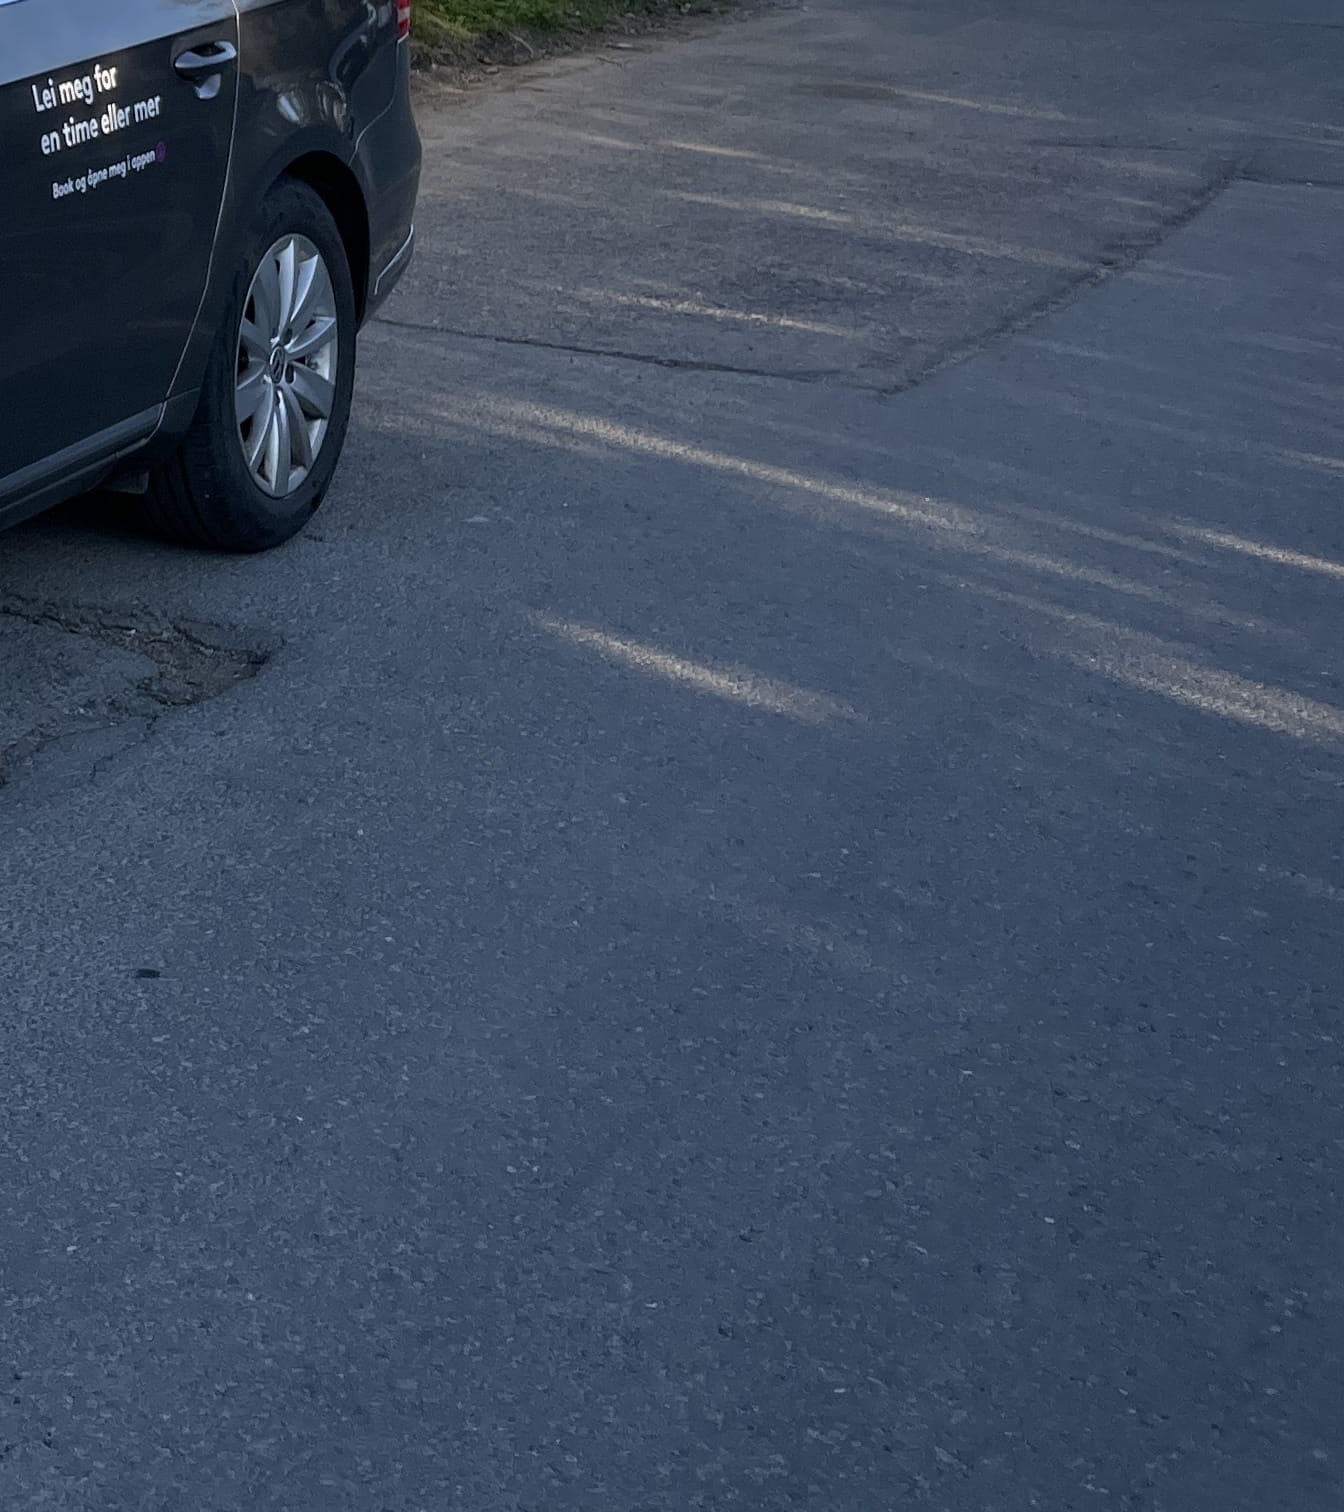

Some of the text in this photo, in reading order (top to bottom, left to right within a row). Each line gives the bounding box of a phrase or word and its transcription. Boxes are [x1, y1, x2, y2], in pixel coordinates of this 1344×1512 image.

[31, 63, 117, 112] Lei meg for
[41, 95, 161, 155] en time eller mer
[52, 177, 74, 199] Book
[75, 176, 87, 194] og
[87, 168, 108, 189] åpne
[108, 161, 127, 178] meg
[131, 150, 156, 172] appen
